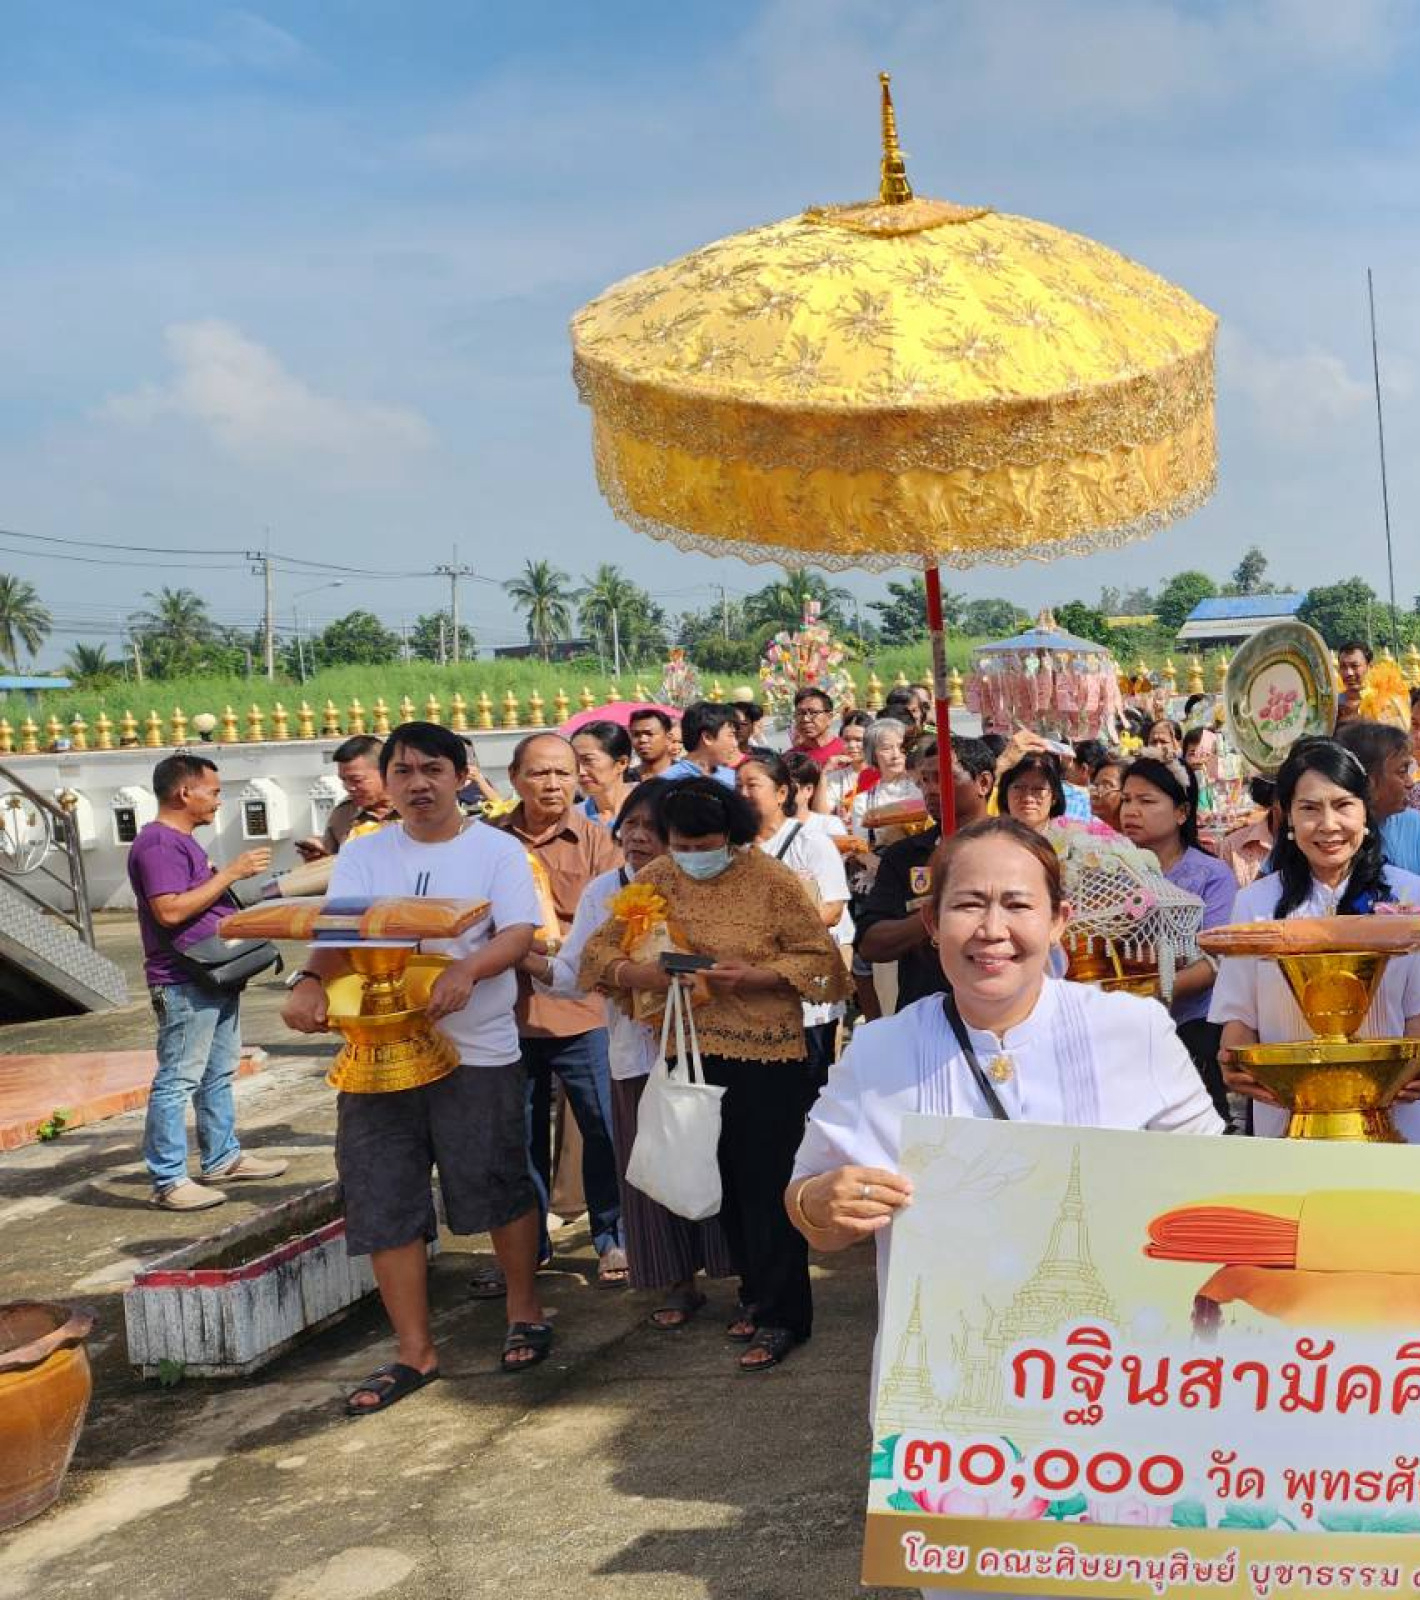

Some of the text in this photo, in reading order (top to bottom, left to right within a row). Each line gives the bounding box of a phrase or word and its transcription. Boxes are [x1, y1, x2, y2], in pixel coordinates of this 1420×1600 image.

[903, 1438, 1184, 1499] ๓๐,๐๐๐
[1207, 1450, 1265, 1499] วัด
[906, 1536, 964, 1571] โดย
[980, 1546, 1237, 1591] คณะศิษยานุศิษย์
[1250, 1563, 1399, 1596] บูชาธรรม
